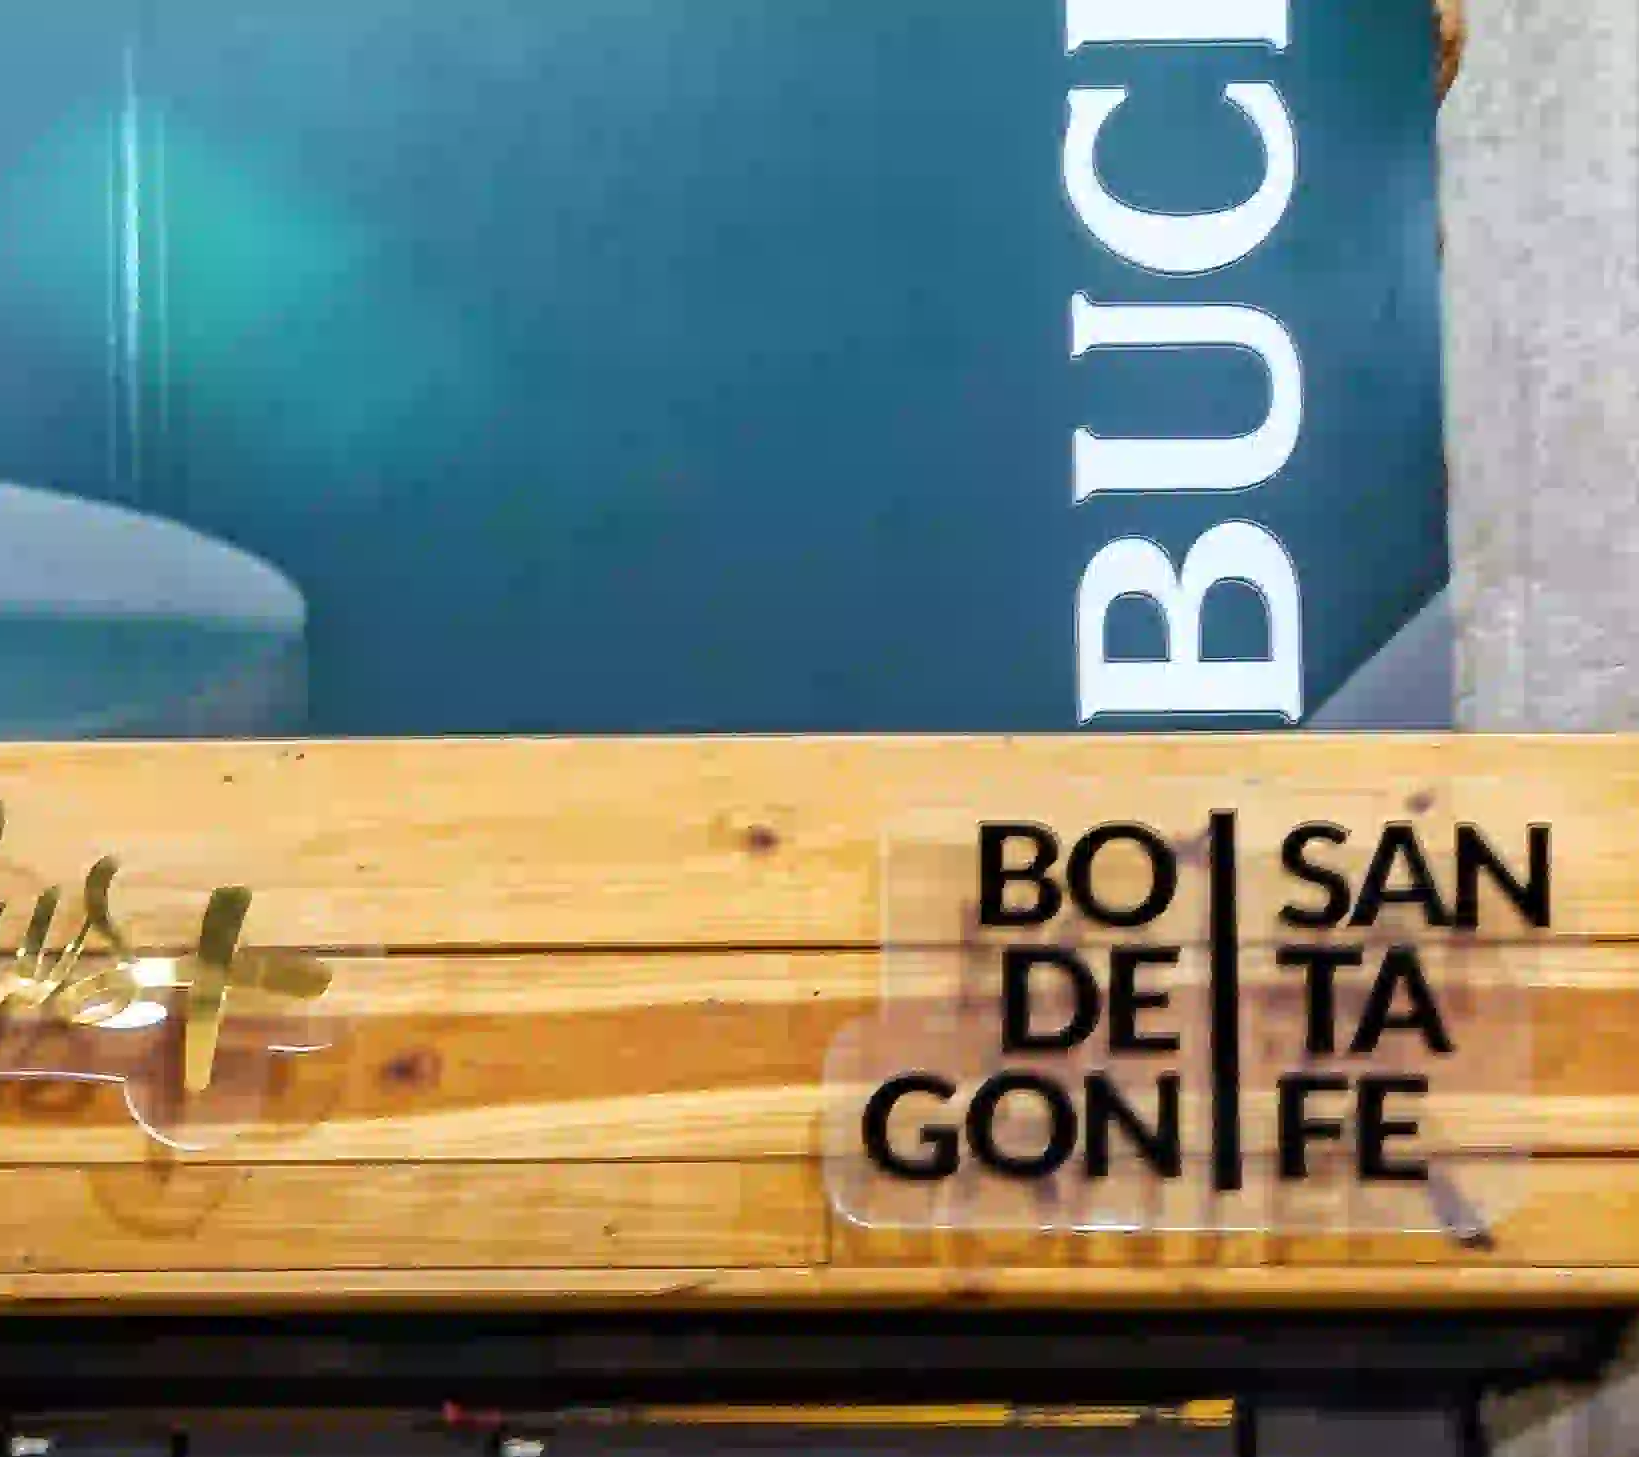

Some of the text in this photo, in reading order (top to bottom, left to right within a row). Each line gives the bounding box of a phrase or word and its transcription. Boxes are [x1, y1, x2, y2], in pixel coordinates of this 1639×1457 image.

[977, 820, 1553, 928] BO SAN
[1000, 943, 1454, 1054] DE TA
[860, 1070, 1431, 1182] GON FE
